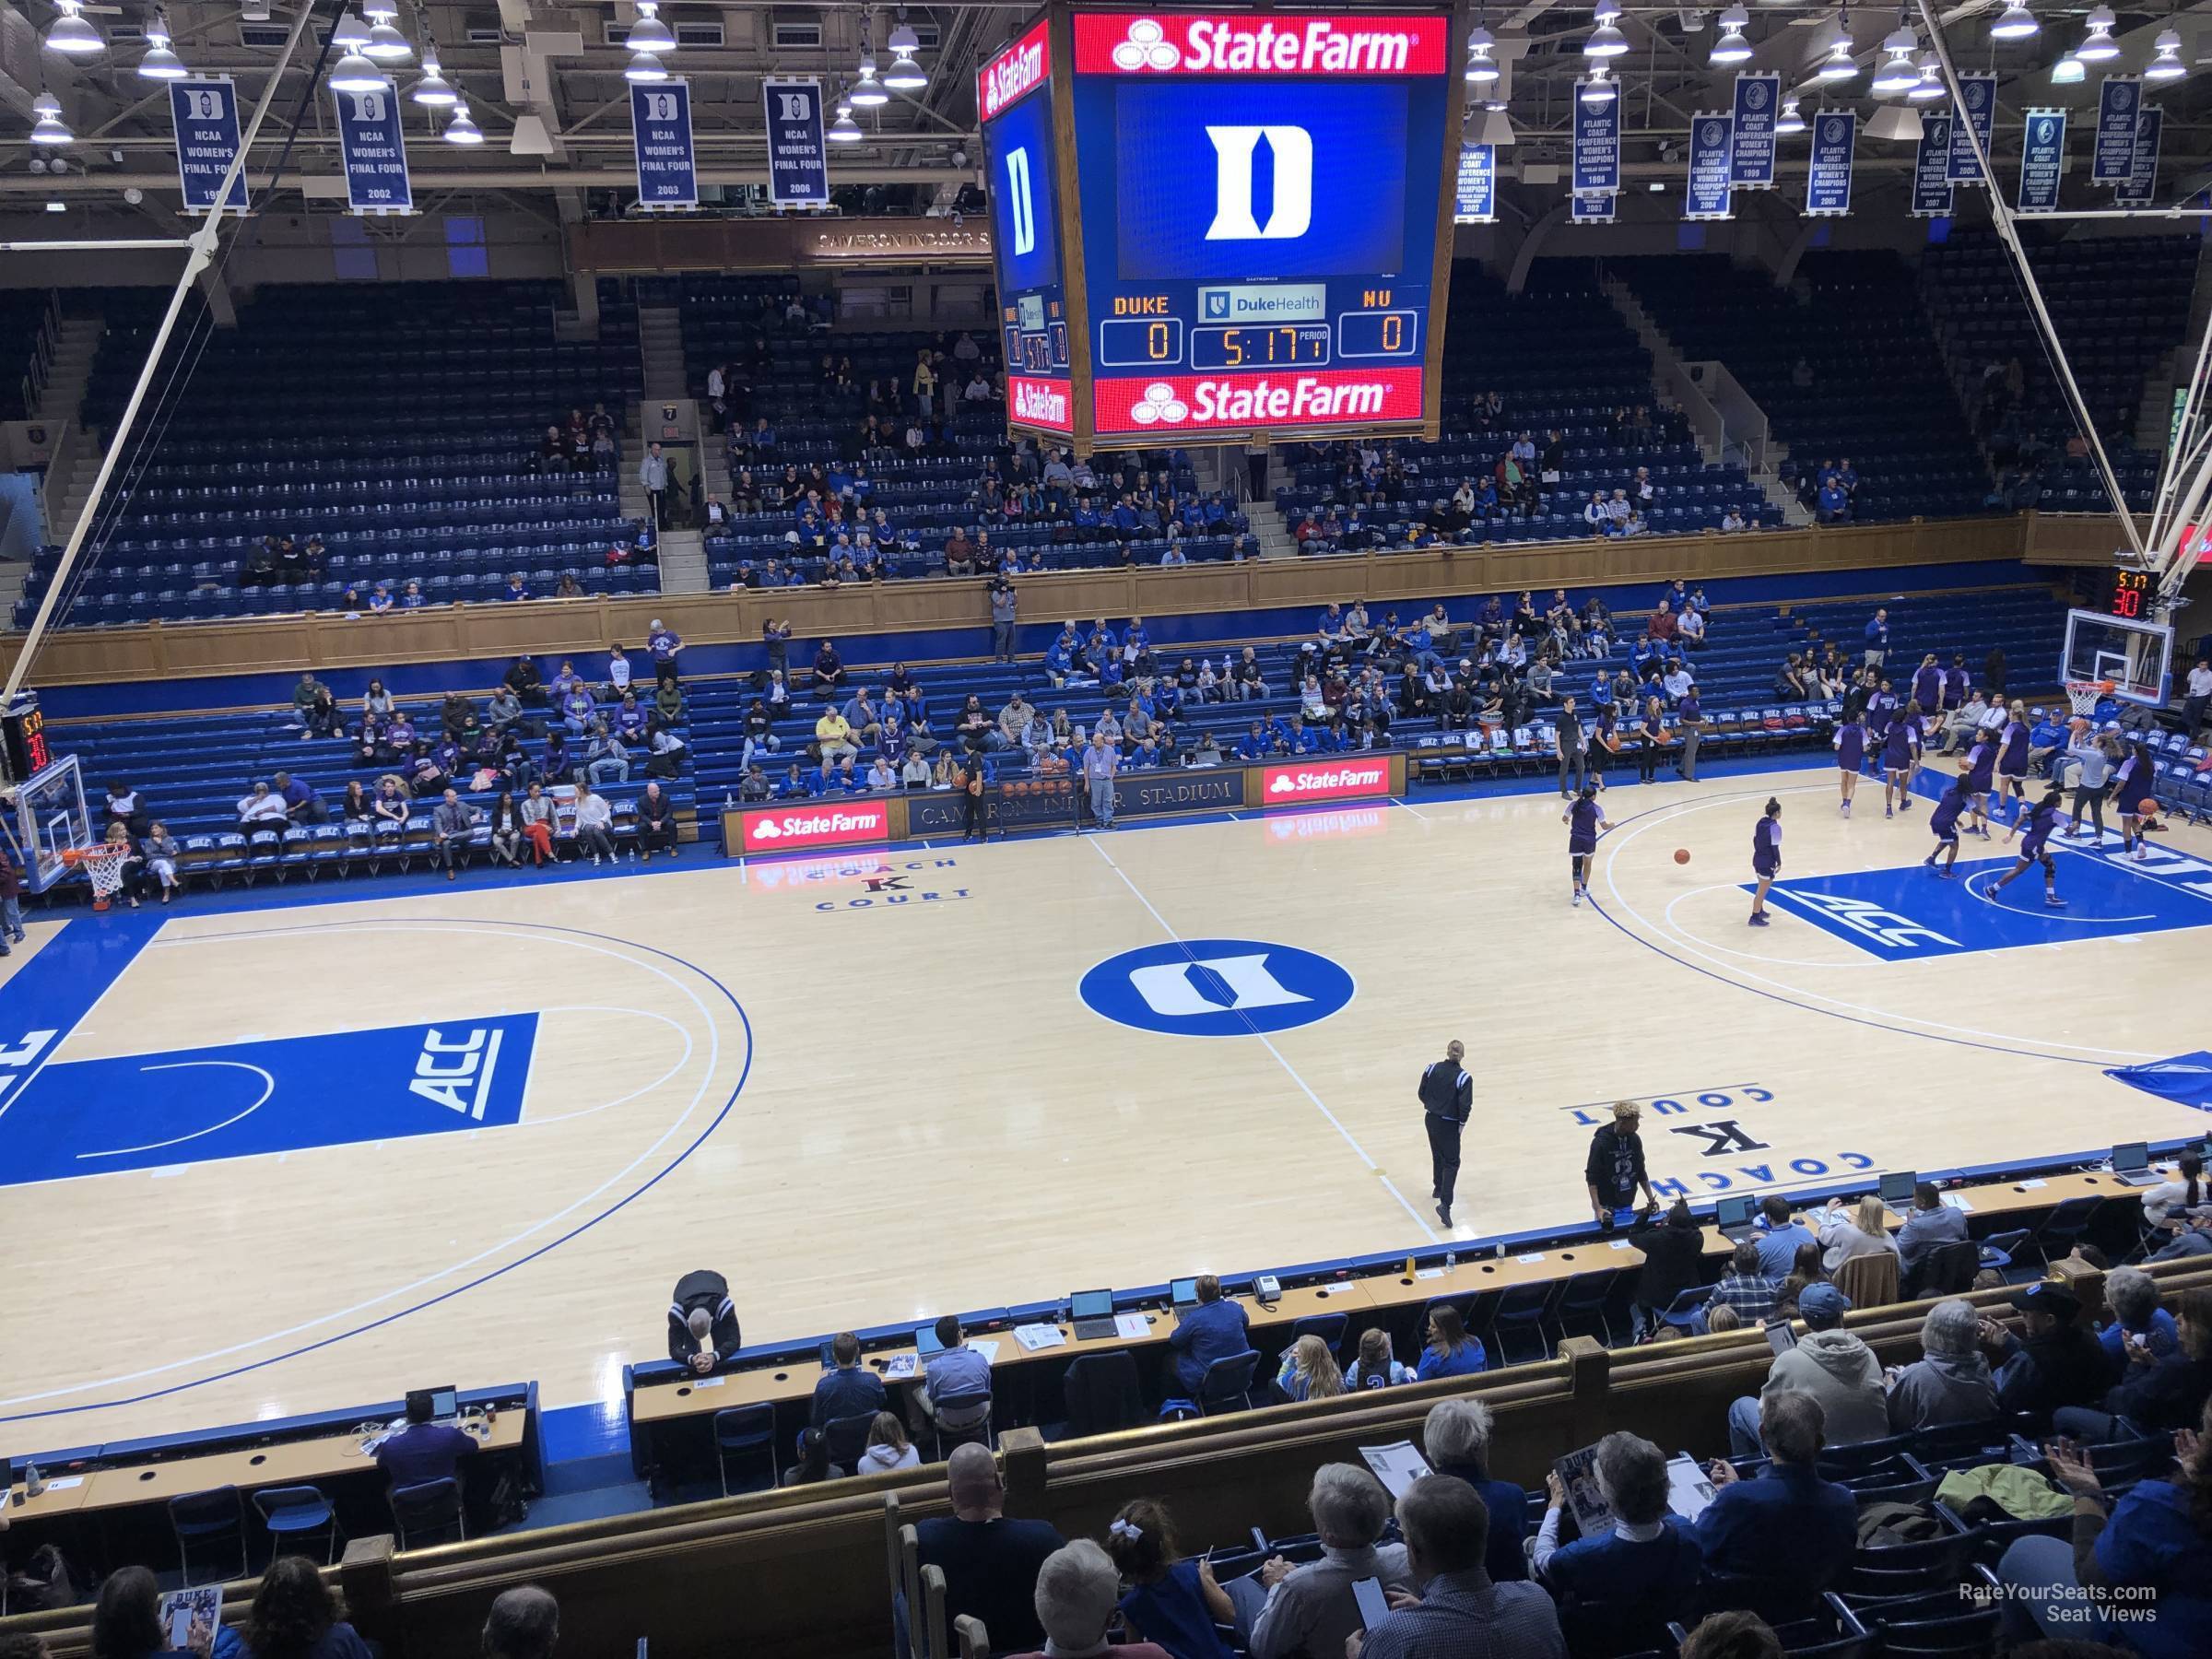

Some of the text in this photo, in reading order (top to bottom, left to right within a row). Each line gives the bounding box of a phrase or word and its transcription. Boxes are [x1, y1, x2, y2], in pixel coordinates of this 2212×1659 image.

[1583, 120, 1611, 128] ATLANTIC
[194, 131, 222, 141] NCAA
[359, 132, 385, 142] NCAA
[652, 131, 676, 140] NCAA
[784, 130, 807, 139] NCAA
[1578, 137, 1617, 146] CONFERENCE
[186, 147, 234, 158] WOMEN'S
[352, 147, 395, 158] WOMEN'S
[644, 146, 685, 156] WOMEN'S
[778, 145, 817, 155] WOMEN'S
[1583, 147, 1611, 155] WOMEN'S
[774, 159, 822, 170] FINAL FOUR
[1579, 155, 1615, 164] CHAMPIONS
[183, 163, 213, 174] FINAL
[350, 163, 404, 174] FINAL FOUR
[641, 161, 690, 171] FINAL FOUR
[1692, 166, 1728, 174] CONFERENCE
[790, 183, 811, 194] 2006
[1814, 179, 1846, 187] CHAMPIONS
[368, 189, 392, 199] 2002
[657, 185, 679, 194] 2003
[818, 233, 901, 248] CAMERON
[908, 232, 973, 247] INDOOR
[1113, 296, 1170, 315] DUKE
[1237, 296, 1320, 312] DukeHealth
[1300, 330, 1327, 341] PERIOD
[1382, 315, 1402, 350] 0
[1148, 323, 1168, 359] 0
[1225, 326, 1297, 366] 5:17
[2112, 588, 2139, 618] 30
[1140, 782, 1230, 806] STADIUM
[347, 823, 369, 835] DUKE
[378, 820, 400, 832] DUKE
[407, 818, 429, 830] DUKE
[253, 831, 276, 843] DUKE
[316, 827, 339, 839] DUKE
[187, 837, 211, 849] DUKE
[218, 834, 244, 846] DUKE
[806, 859, 957, 879] COACH
[861, 876, 914, 892] K
[816, 888, 970, 911] COURT
[1792, 890, 1965, 947] ACC
[408, 1028, 487, 1114] ACC
[1571, 1087, 1775, 1126] COUT
[1668, 1120, 1772, 1157] K
[1649, 1152, 1875, 1197] COACH
[177, 1589, 211, 1603] DUKE
